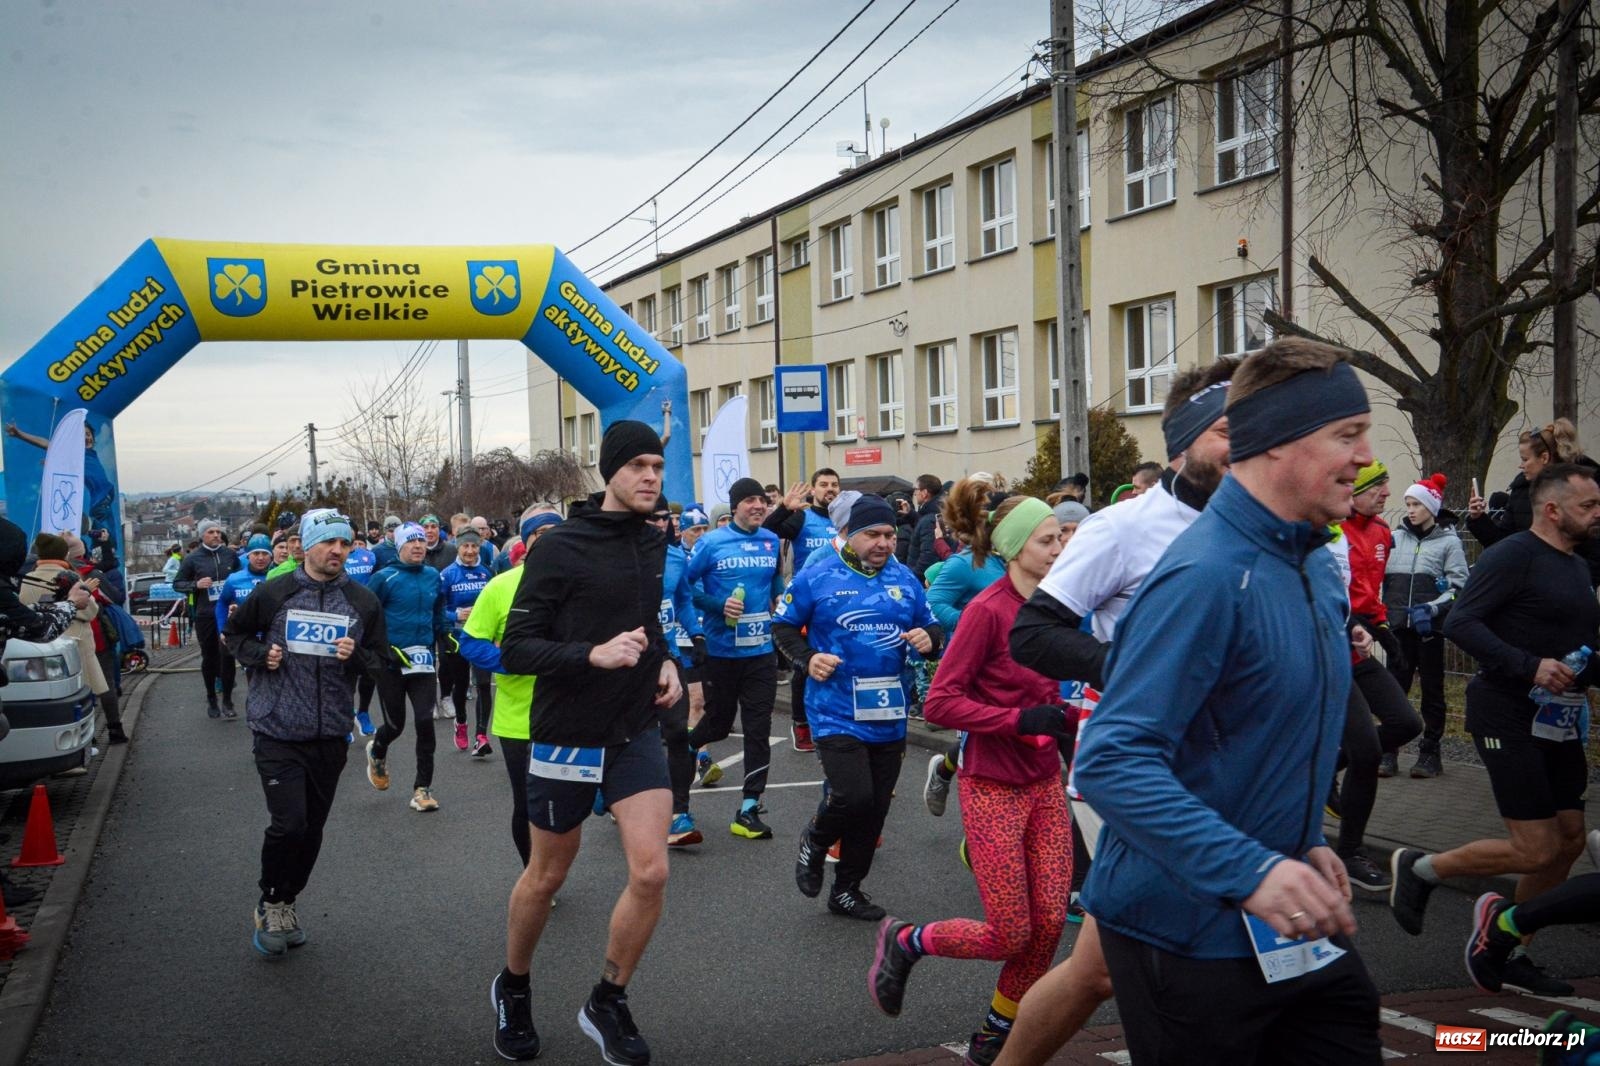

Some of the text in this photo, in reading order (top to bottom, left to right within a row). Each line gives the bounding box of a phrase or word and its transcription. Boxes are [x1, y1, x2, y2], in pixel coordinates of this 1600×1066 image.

[316, 259, 421, 275] Gmina
[290, 279, 449, 298] Pietrowice
[312, 303, 429, 320] Wielkie
[47, 276, 166, 383] Gmina ludzi
[559, 280, 660, 376] Gmina ludzi
[77, 303, 186, 401] aktywnych
[543, 304, 640, 392] aktywnych
[295, 622, 337, 643] 230
[747, 622, 764, 636] 32
[848, 623, 895, 632] ZŁOM-MAX
[877, 689, 890, 707] 3
